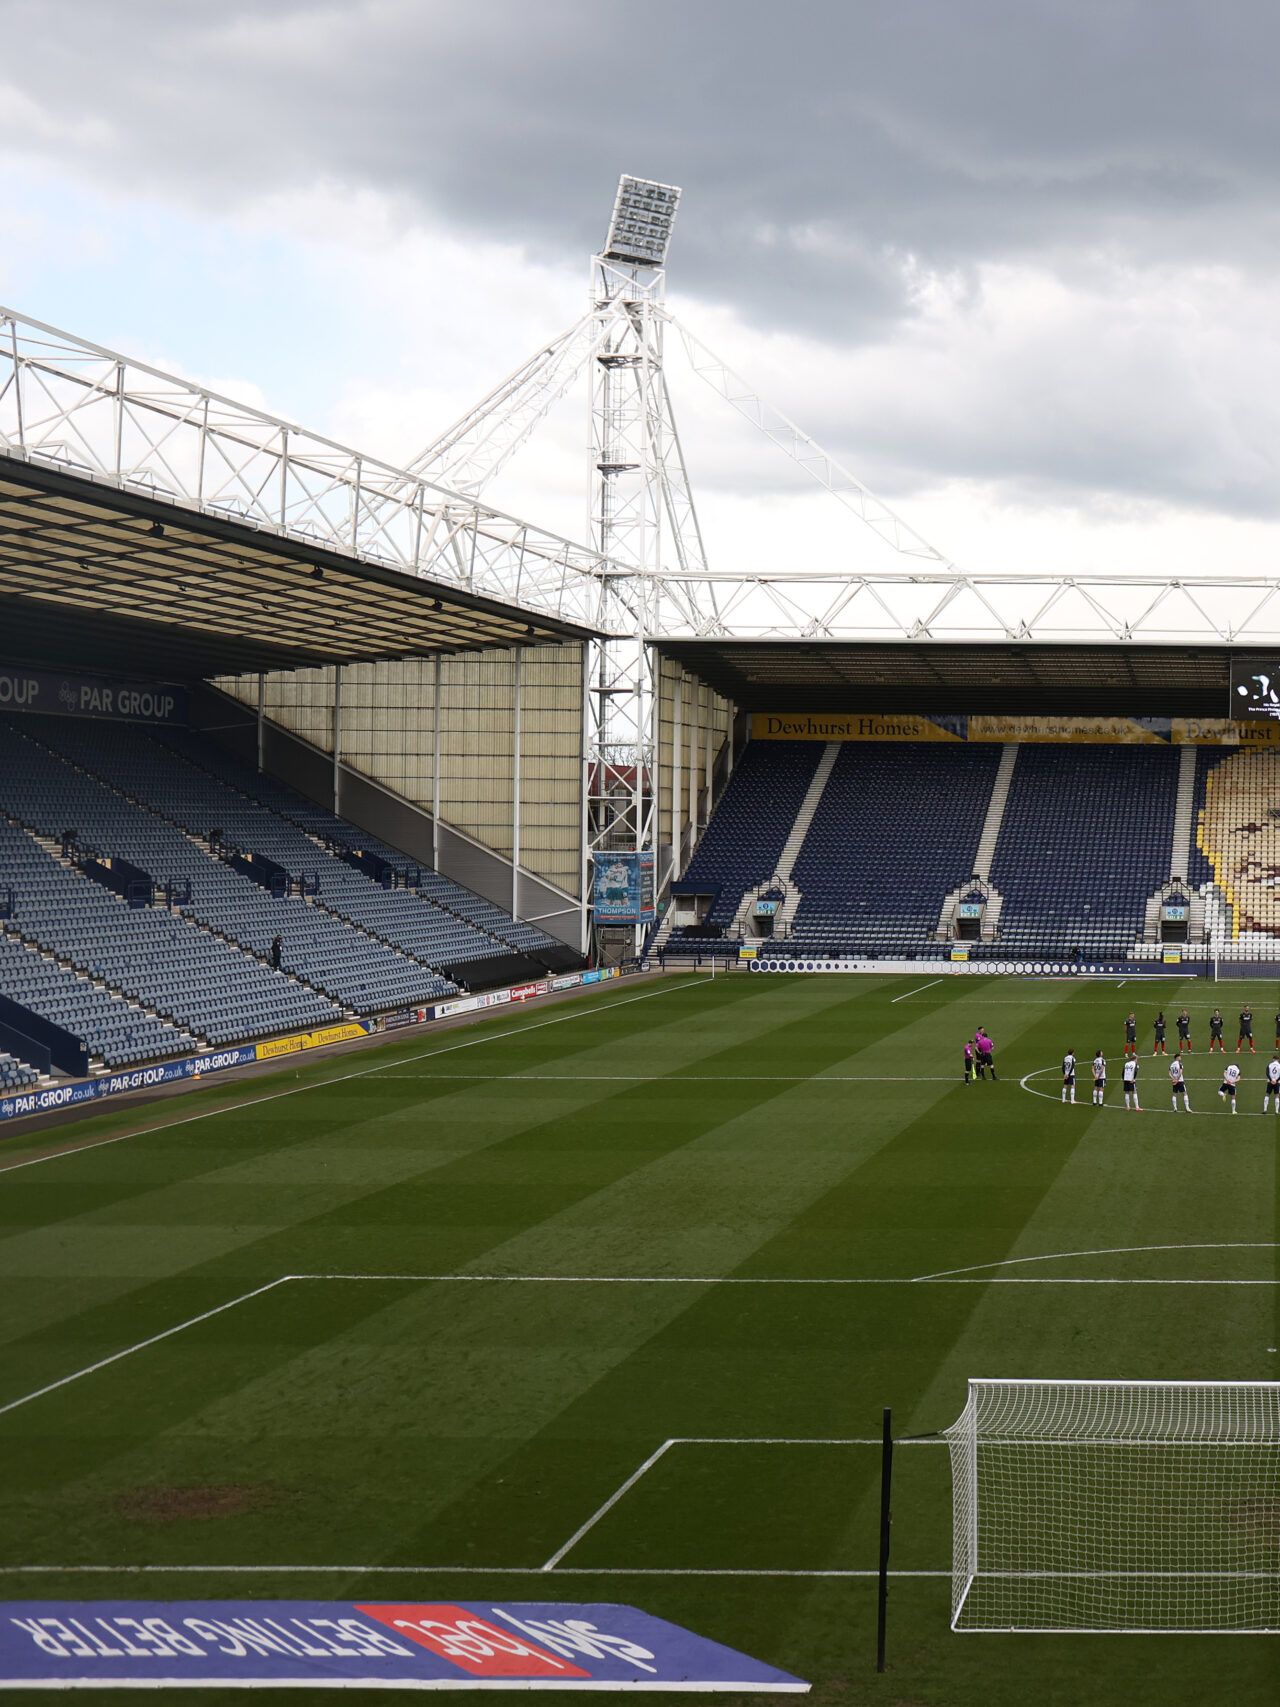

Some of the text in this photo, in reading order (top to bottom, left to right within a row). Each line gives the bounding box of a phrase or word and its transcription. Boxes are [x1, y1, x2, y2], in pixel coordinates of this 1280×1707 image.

[80, 686, 174, 718] PAR GROUP
[767, 717, 920, 736] Dewhurst Homes
[1186, 722, 1272, 740] Dewhurst
[318, 1027, 358, 1044] Dewhurst Homes
[262, 1037, 308, 1056] Dewhurst Homes
[194, 1050, 255, 1074] PAR-GROUP.co.uk
[1271, 1066, 1277, 1075] 6
[10, 1617, 207, 1658] BETTER
[183, 1617, 416, 1658] BETTING
[393, 1619, 565, 1669] bet
